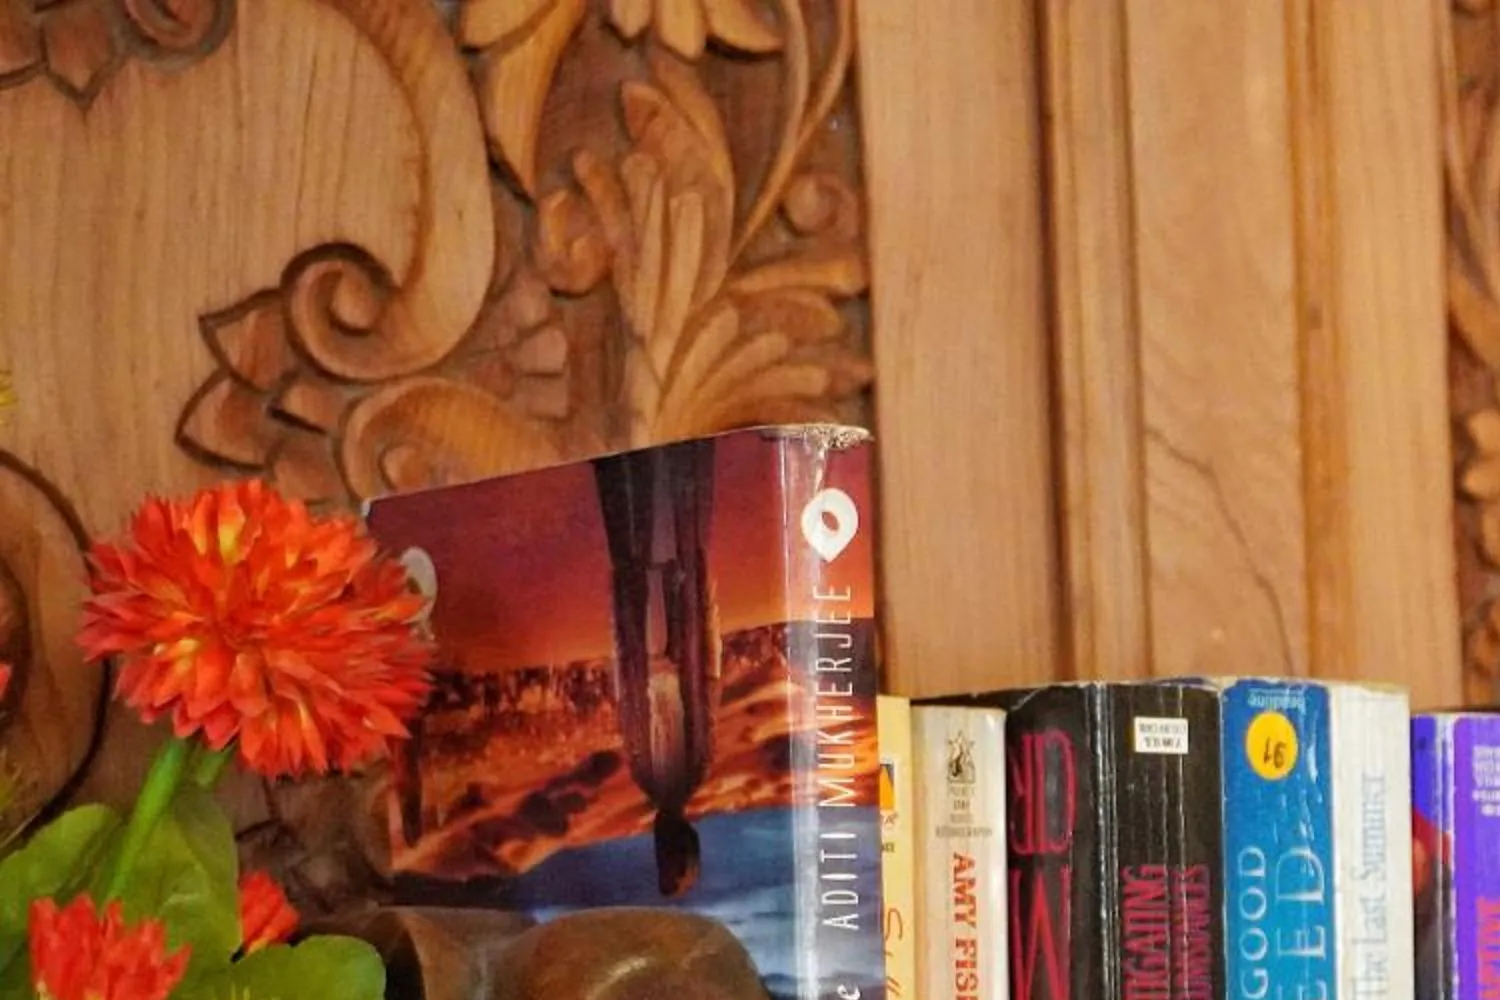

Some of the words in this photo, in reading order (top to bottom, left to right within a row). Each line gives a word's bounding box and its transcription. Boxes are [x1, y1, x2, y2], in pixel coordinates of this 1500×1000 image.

[813, 583, 857, 808] MUKHERJEE
[820, 832, 860, 931] ADITI
[951, 851, 979, 930] AMY
[1237, 844, 1270, 1000] GOOD
[1350, 892, 1389, 946] Last
